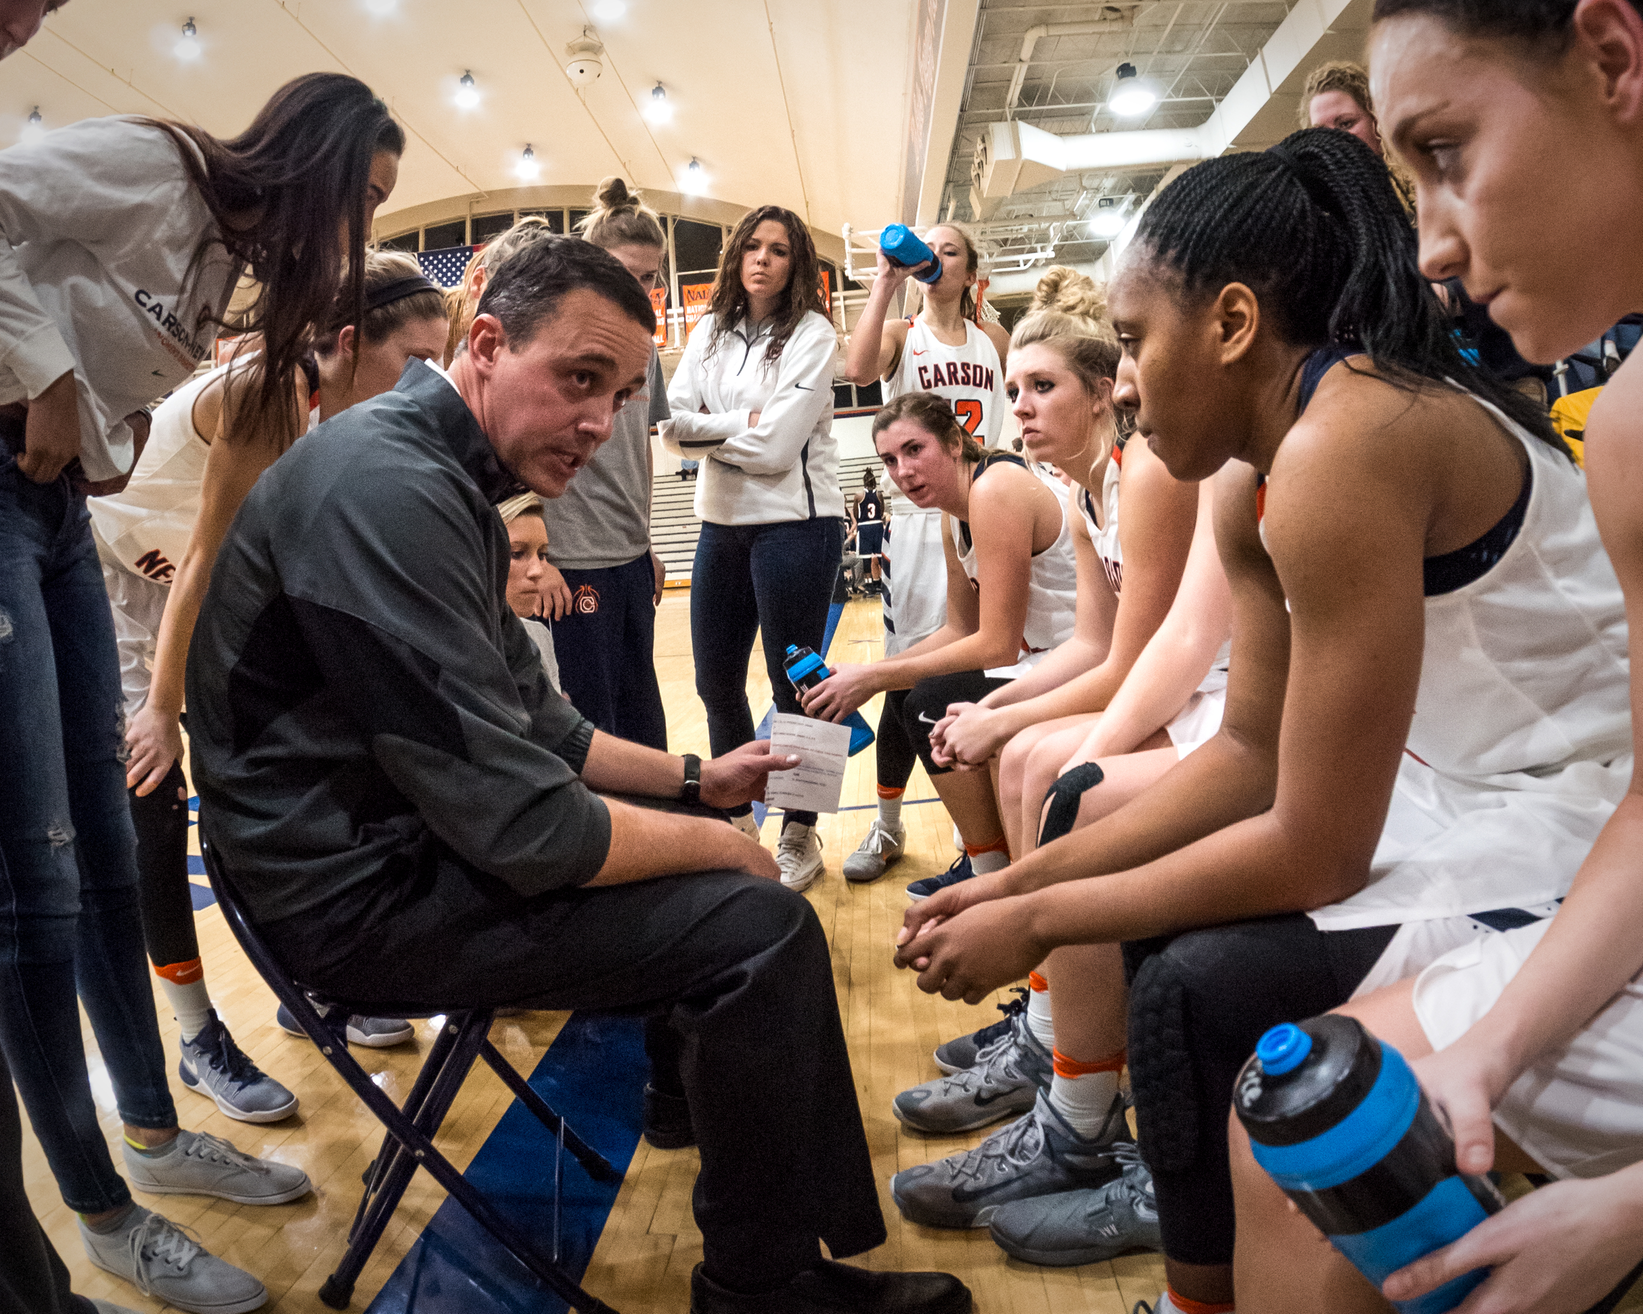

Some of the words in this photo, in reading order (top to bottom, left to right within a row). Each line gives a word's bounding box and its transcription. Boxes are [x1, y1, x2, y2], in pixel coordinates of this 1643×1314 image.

[918, 361, 994, 392] CARSON
[944, 398, 986, 447] 2
[867, 502, 876, 519] 3
[134, 548, 177, 584] NE
